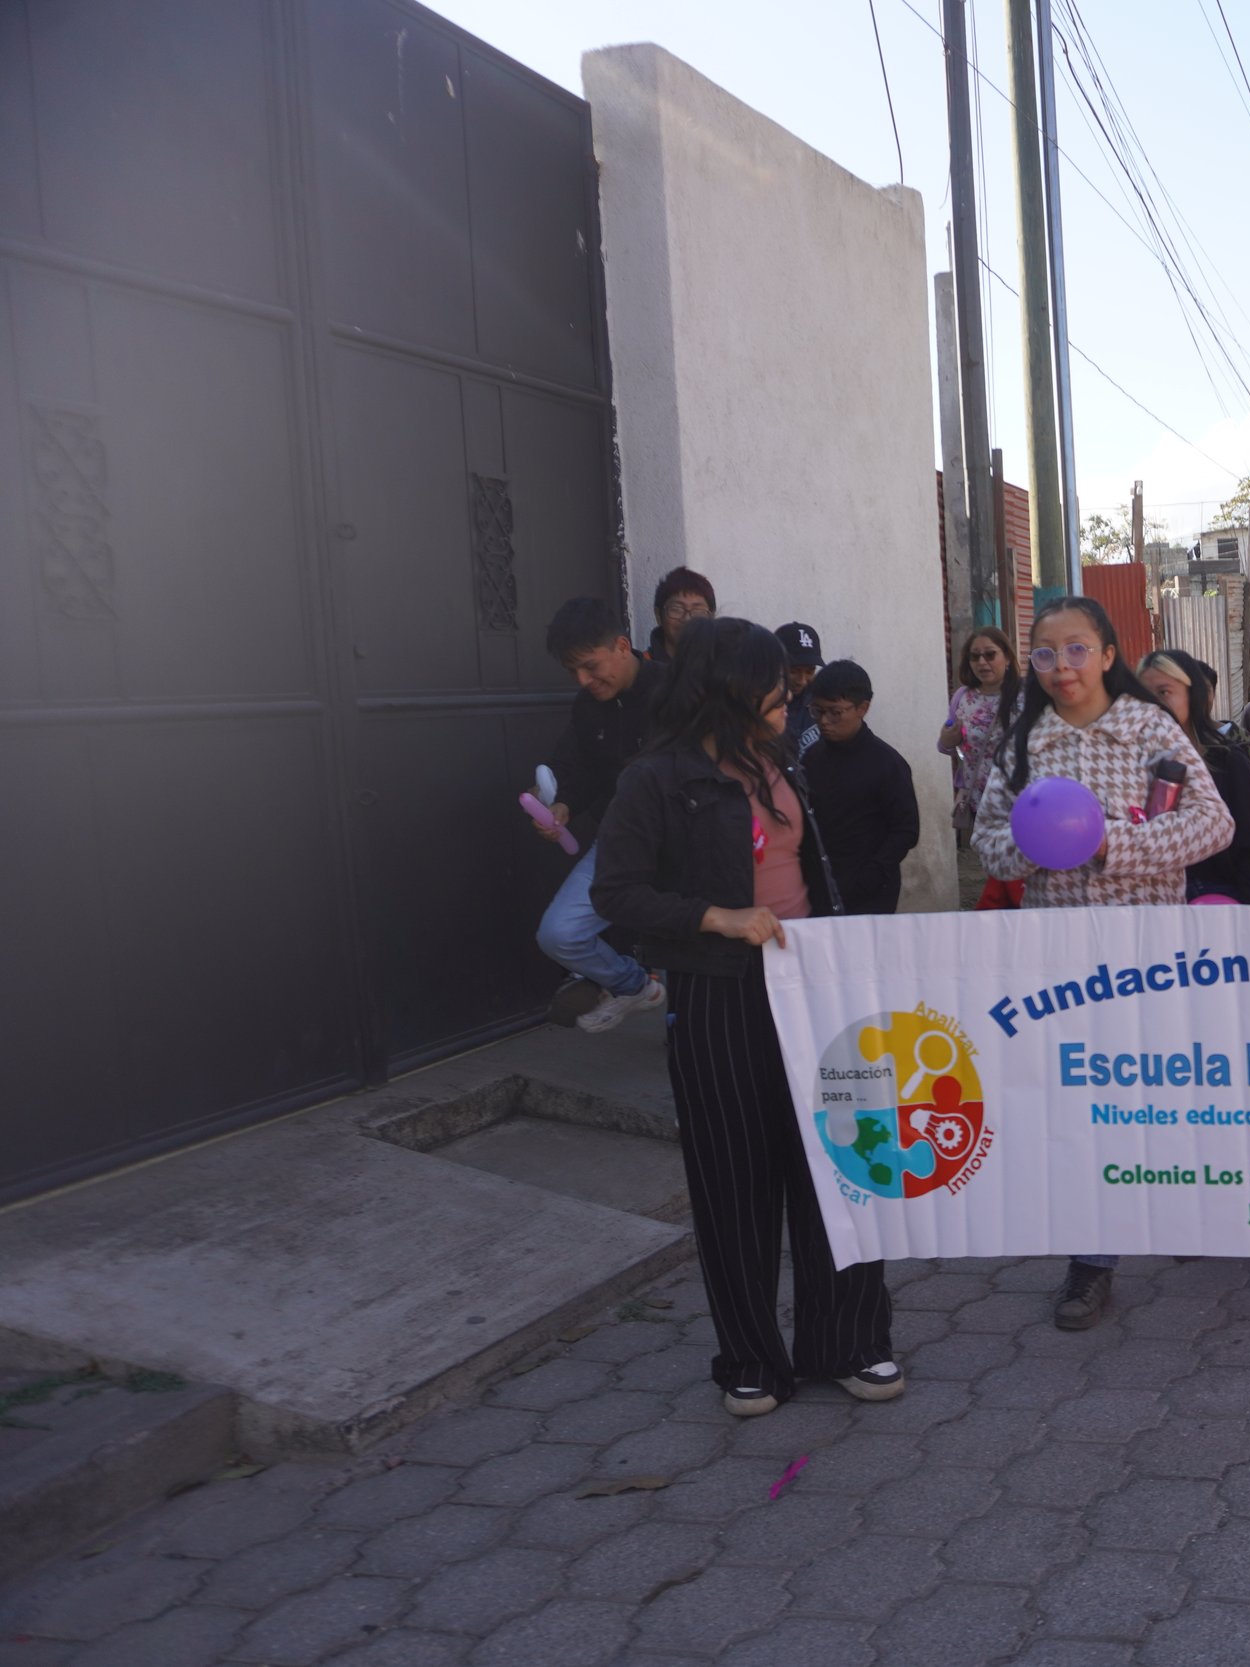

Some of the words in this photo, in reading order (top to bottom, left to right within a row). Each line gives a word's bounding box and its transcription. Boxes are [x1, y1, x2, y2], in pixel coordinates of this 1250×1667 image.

[798, 629, 814, 648] LA
[988, 948, 1249, 1038] Fundación
[912, 1000, 981, 1058] Analizar
[819, 1065, 893, 1081] Educación
[1058, 1042, 1231, 1087] Escuela
[821, 1090, 853, 1105] para
[1090, 1103, 1179, 1126] Niveles
[945, 1126, 995, 1196] Innovar
[1102, 1163, 1196, 1186] Colonia
[1203, 1164, 1244, 1187] Los
